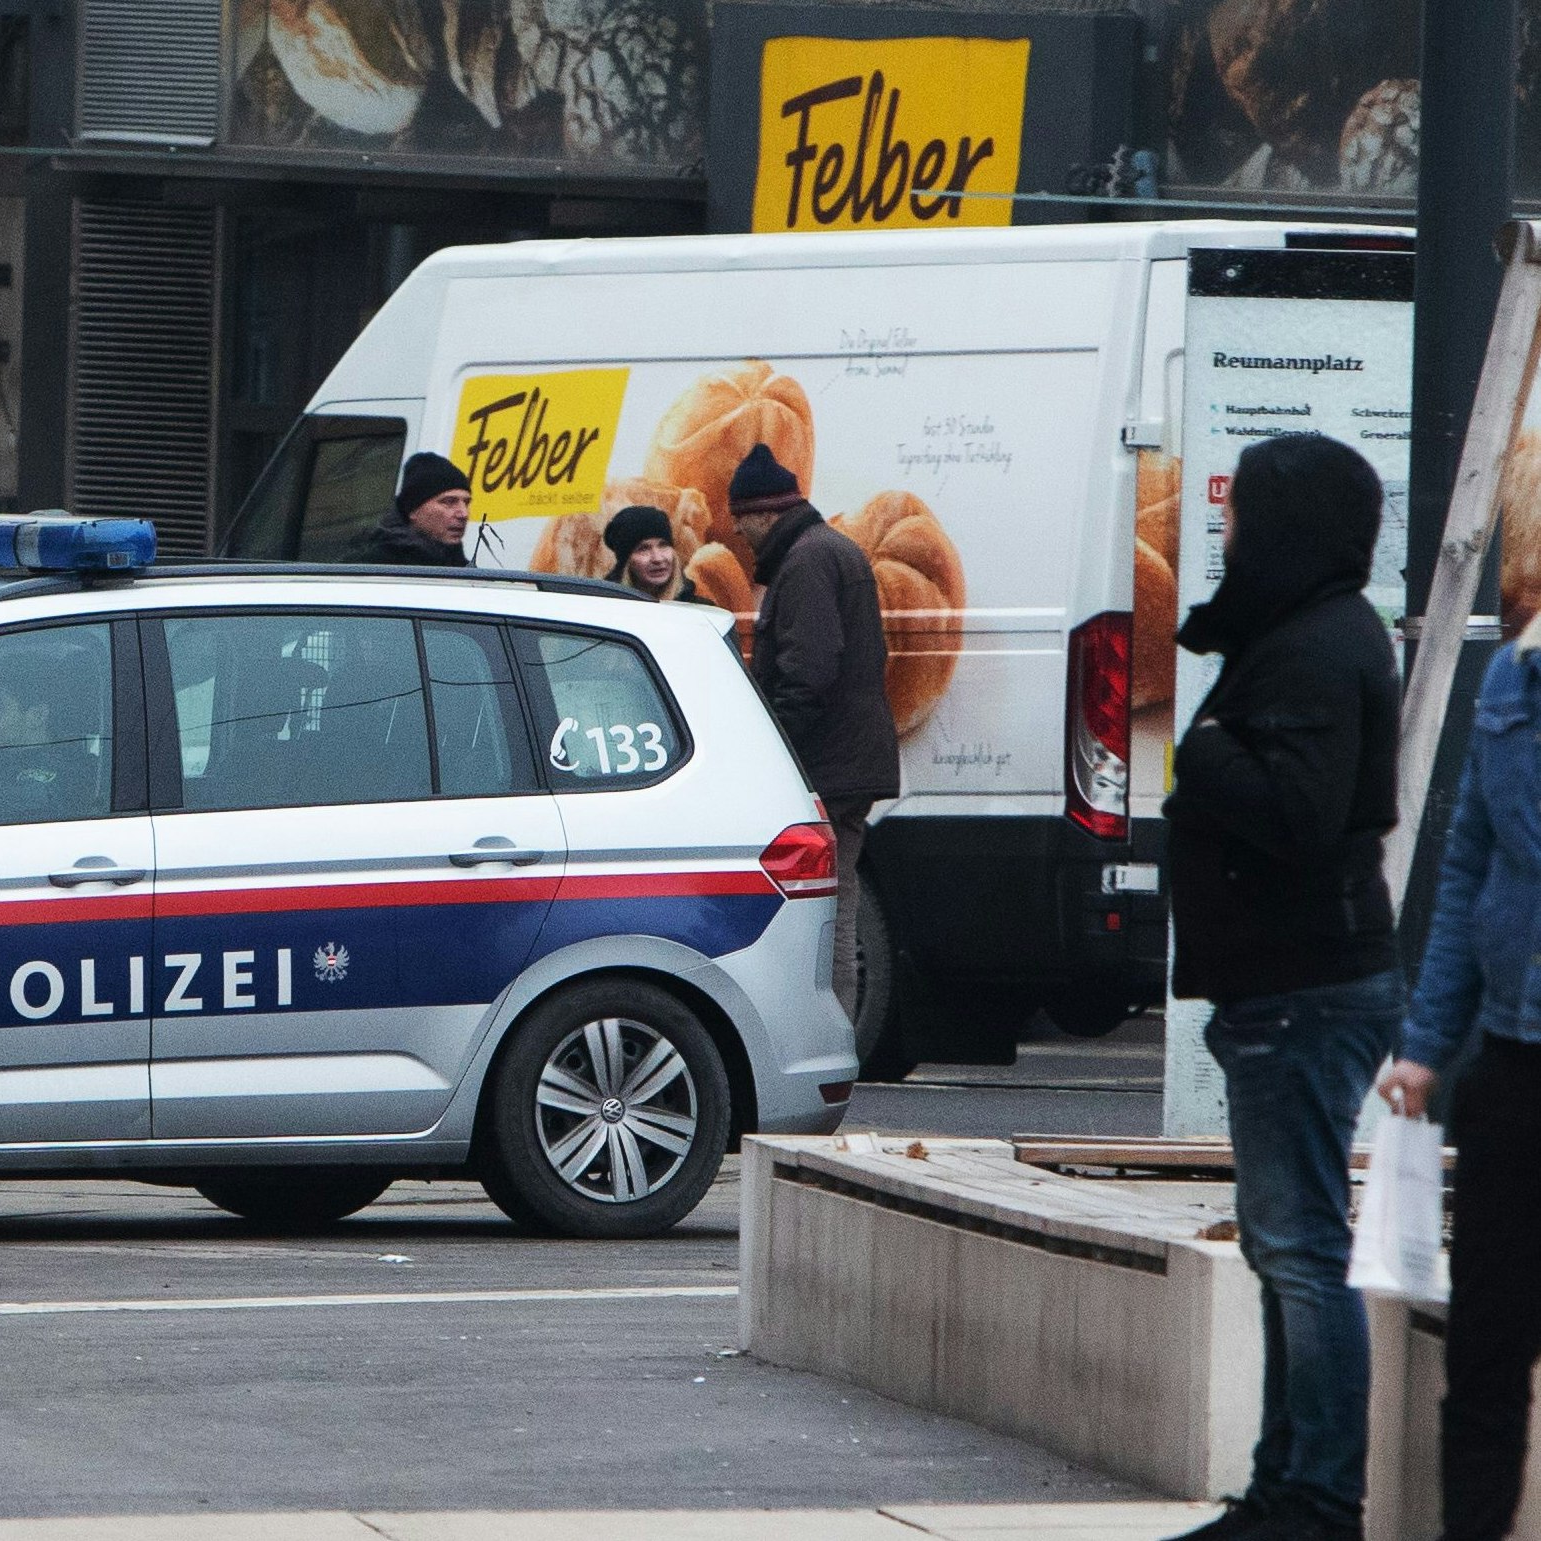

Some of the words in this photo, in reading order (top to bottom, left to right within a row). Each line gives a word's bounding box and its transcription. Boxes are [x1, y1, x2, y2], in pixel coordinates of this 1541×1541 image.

[781, 69, 994, 228] Felber
[1213, 351, 1364, 374] Reumannplatz
[1225, 404, 1312, 416] Hauptbahnhof
[467, 386, 599, 493] Felber
[585, 722, 668, 774] 133
